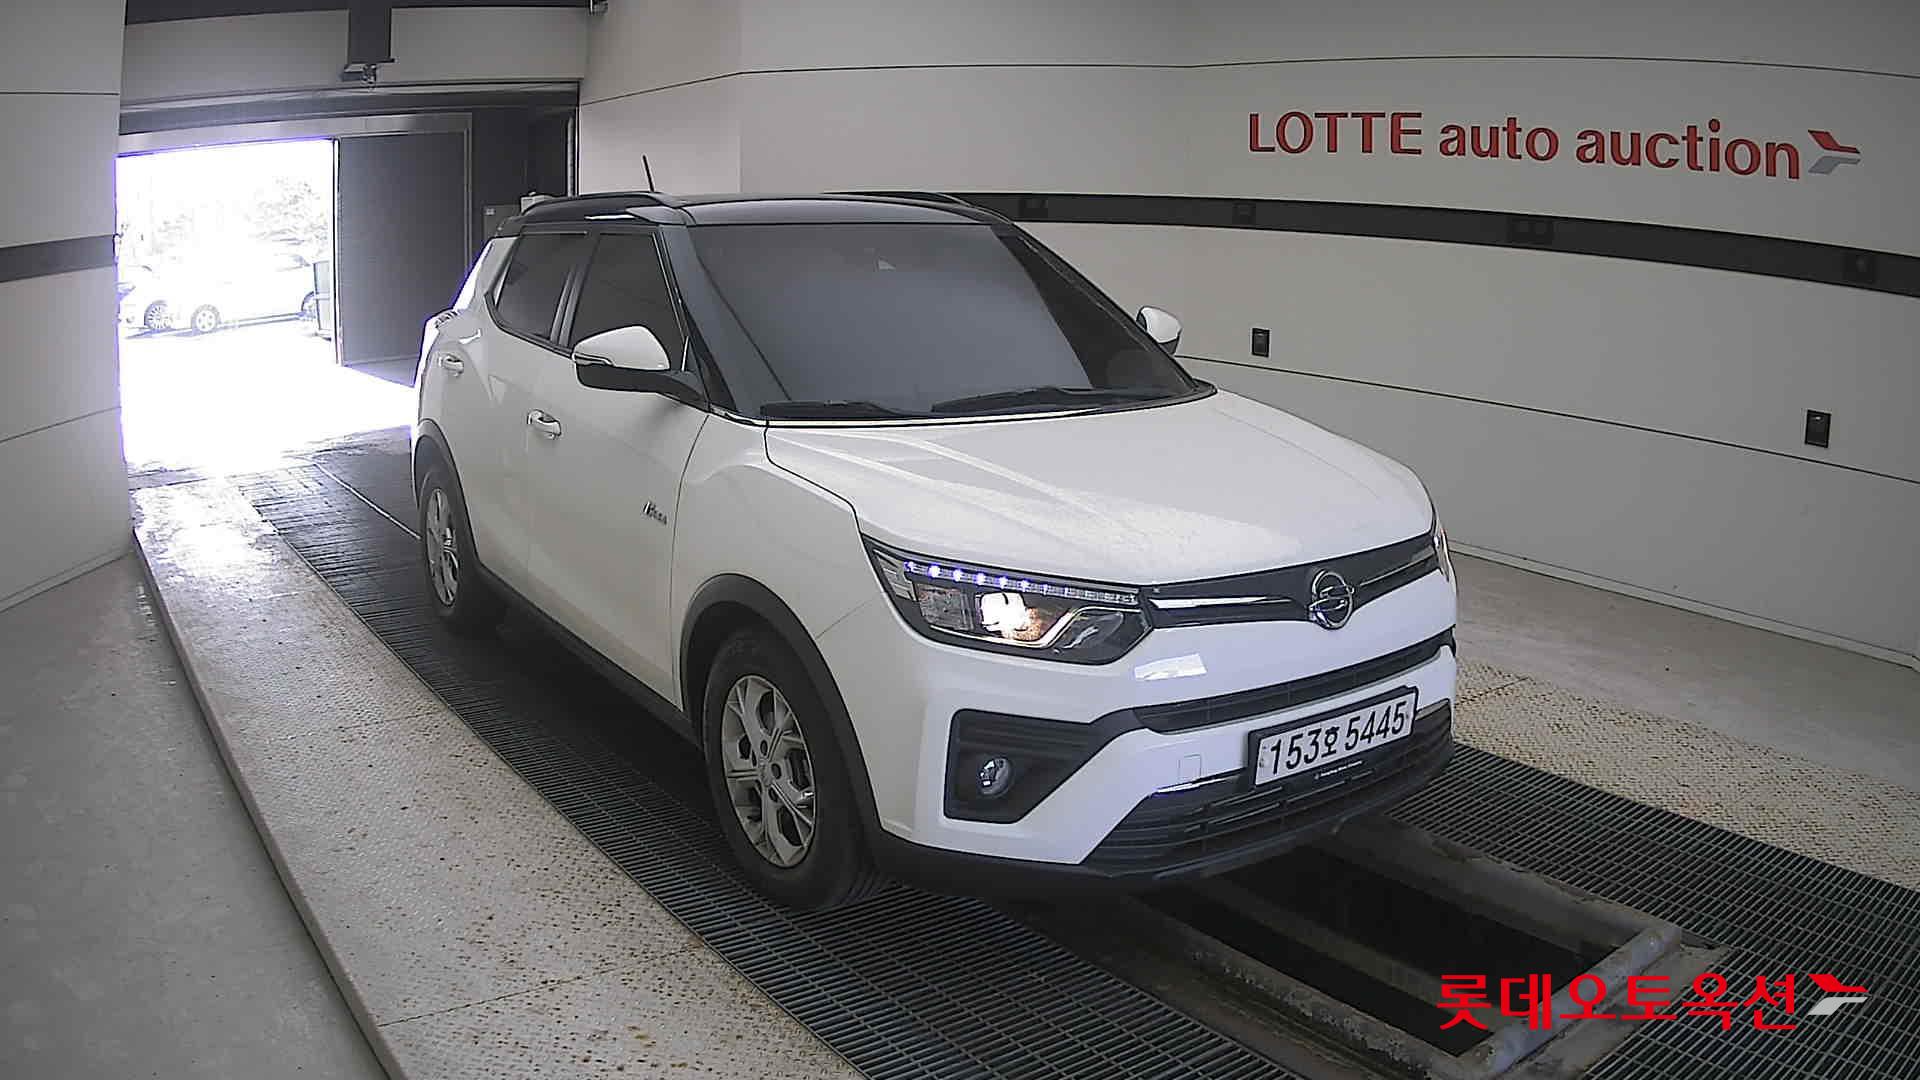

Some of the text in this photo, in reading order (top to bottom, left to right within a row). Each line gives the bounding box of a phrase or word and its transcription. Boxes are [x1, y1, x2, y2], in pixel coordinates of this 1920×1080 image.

[1248, 111, 1801, 179] LOTTE auto auction
[1344, 700, 1408, 751] 5445
